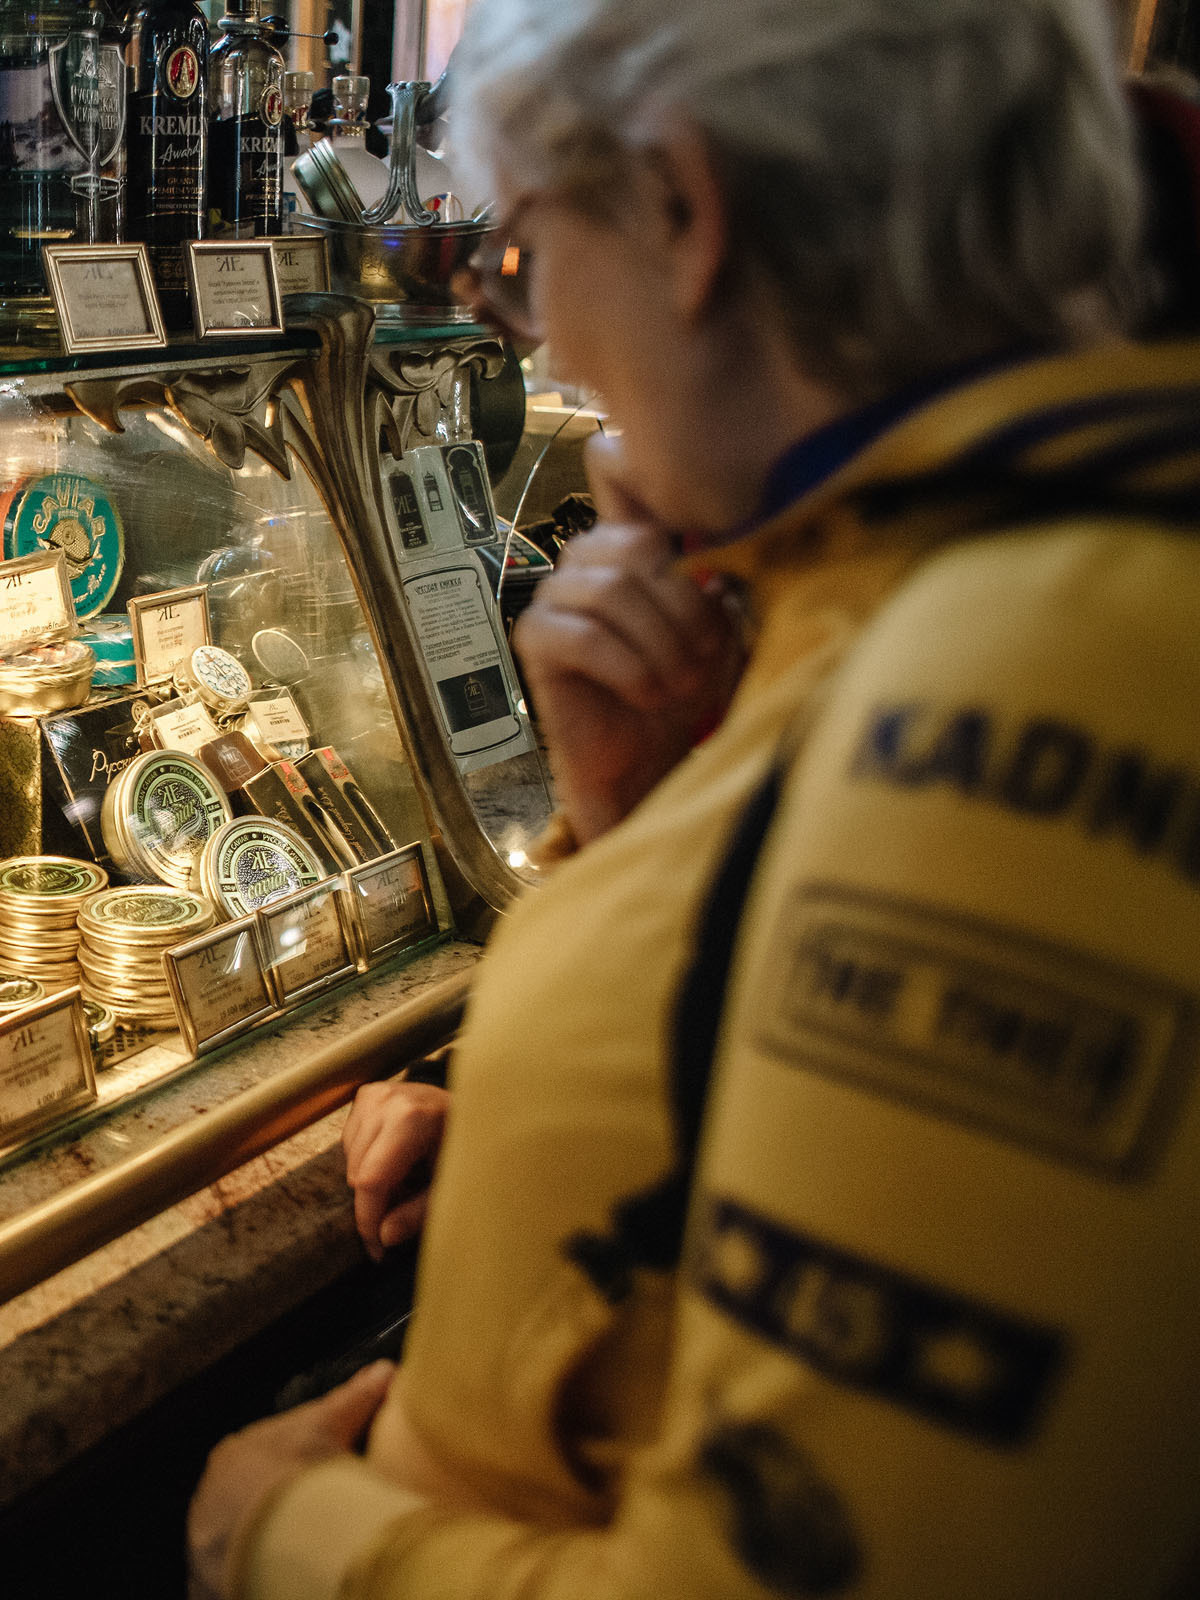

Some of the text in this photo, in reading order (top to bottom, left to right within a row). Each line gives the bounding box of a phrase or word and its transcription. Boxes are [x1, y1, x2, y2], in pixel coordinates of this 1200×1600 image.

[140, 115, 208, 136] KREMLN
[159, 138, 201, 165] Award
[247, 868, 289, 899] caviar
